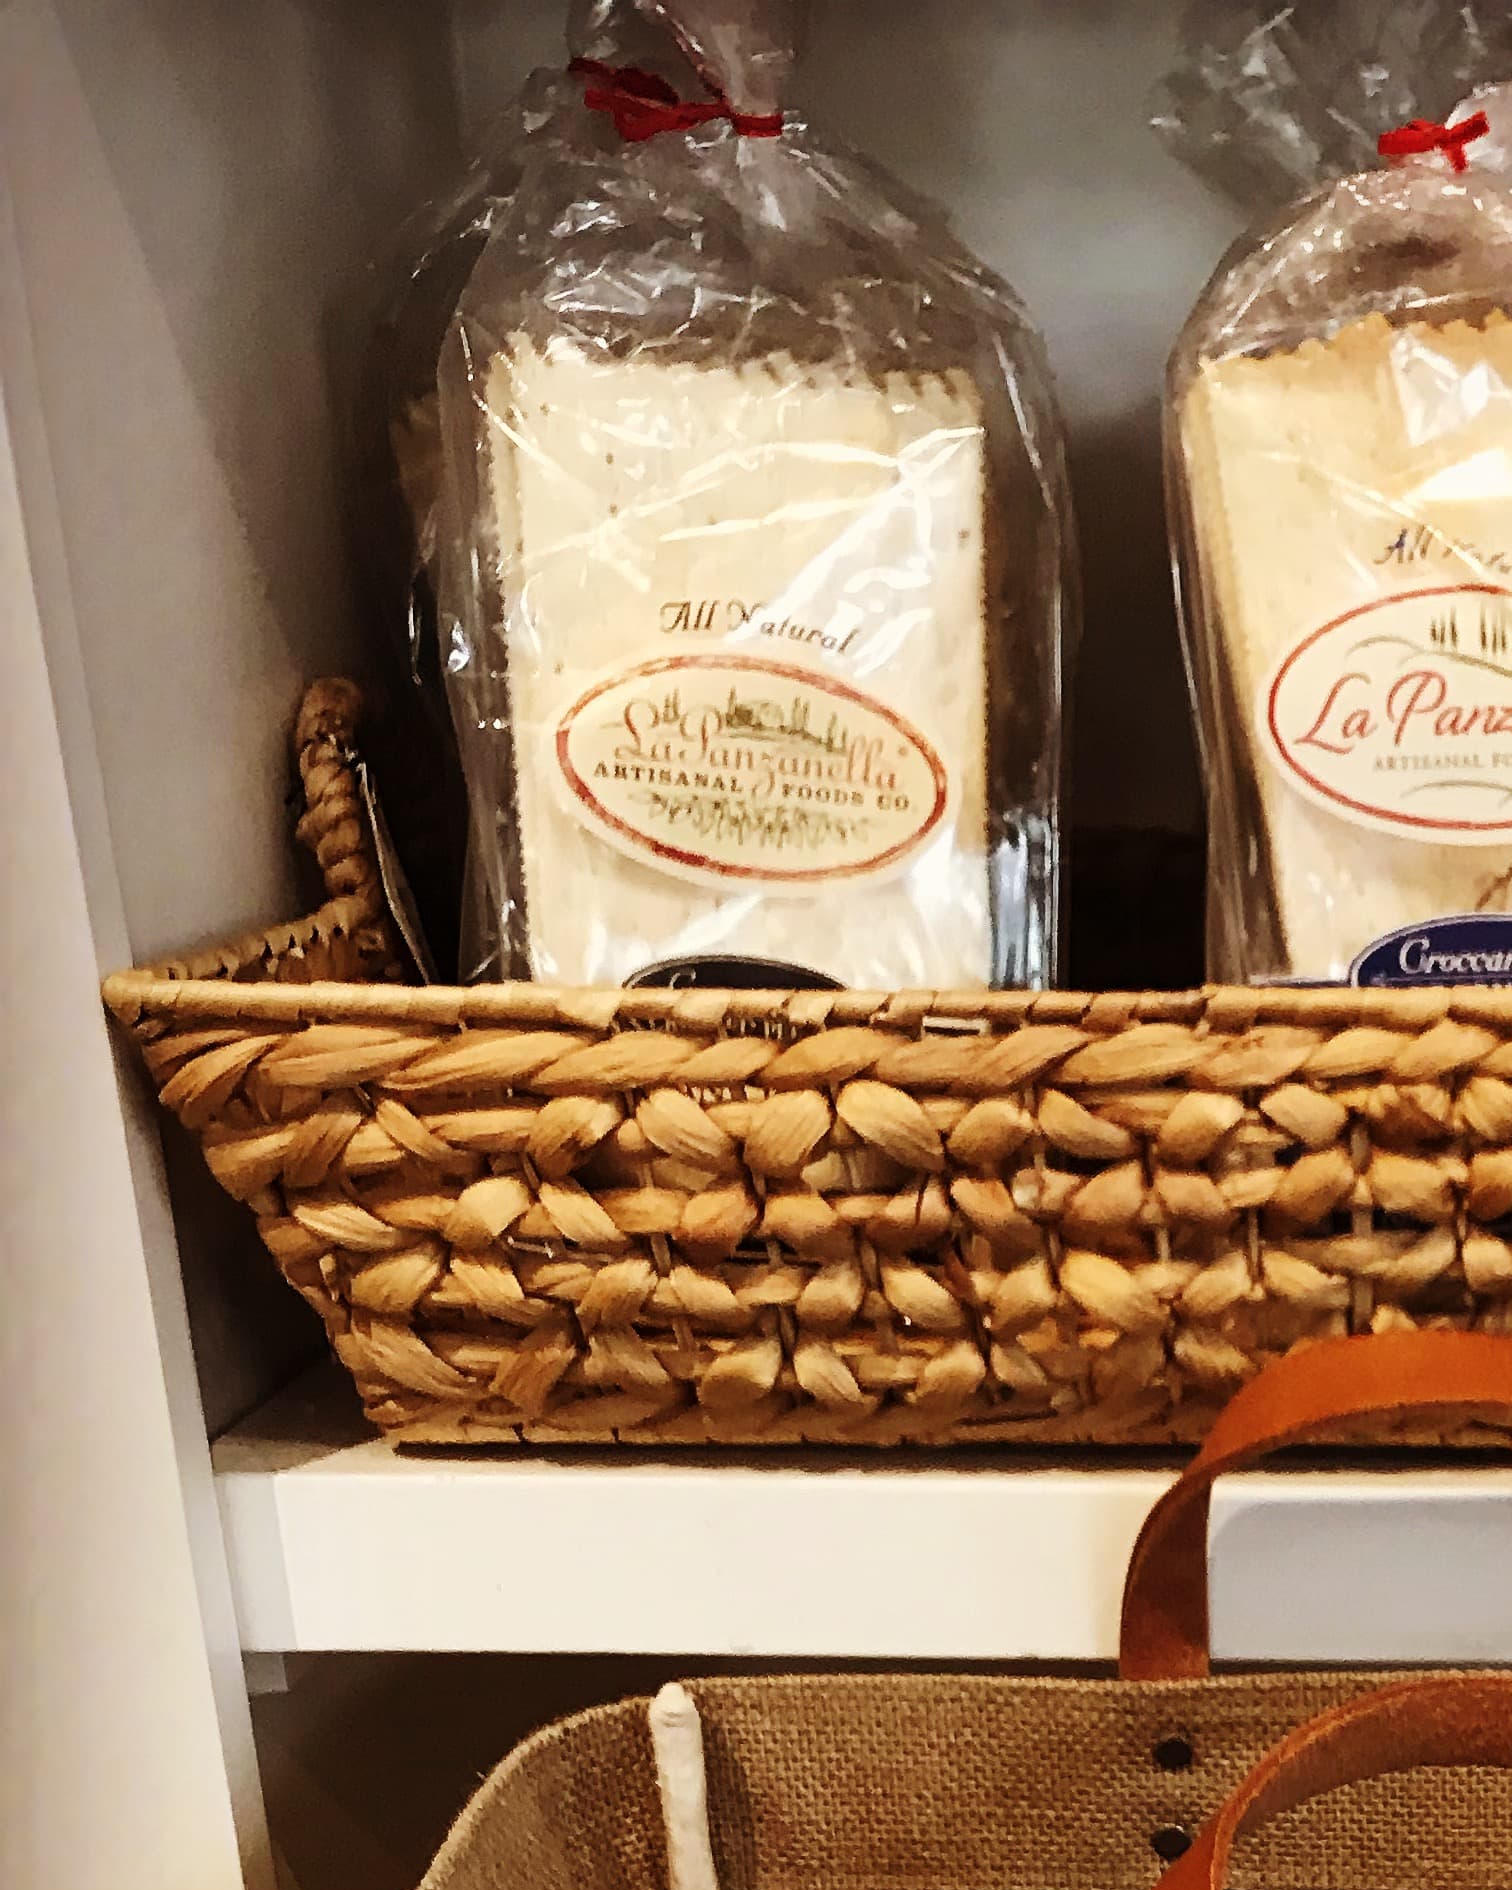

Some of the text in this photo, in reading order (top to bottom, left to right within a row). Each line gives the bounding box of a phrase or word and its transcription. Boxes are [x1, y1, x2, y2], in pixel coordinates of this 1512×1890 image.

[659, 598, 862, 655] All Natural
[1294, 672, 1378, 755] La
[593, 760, 742, 793] ARTISANAL
[782, 783, 865, 806] FOODS
[1373, 755, 1481, 772] ARTISANAL
